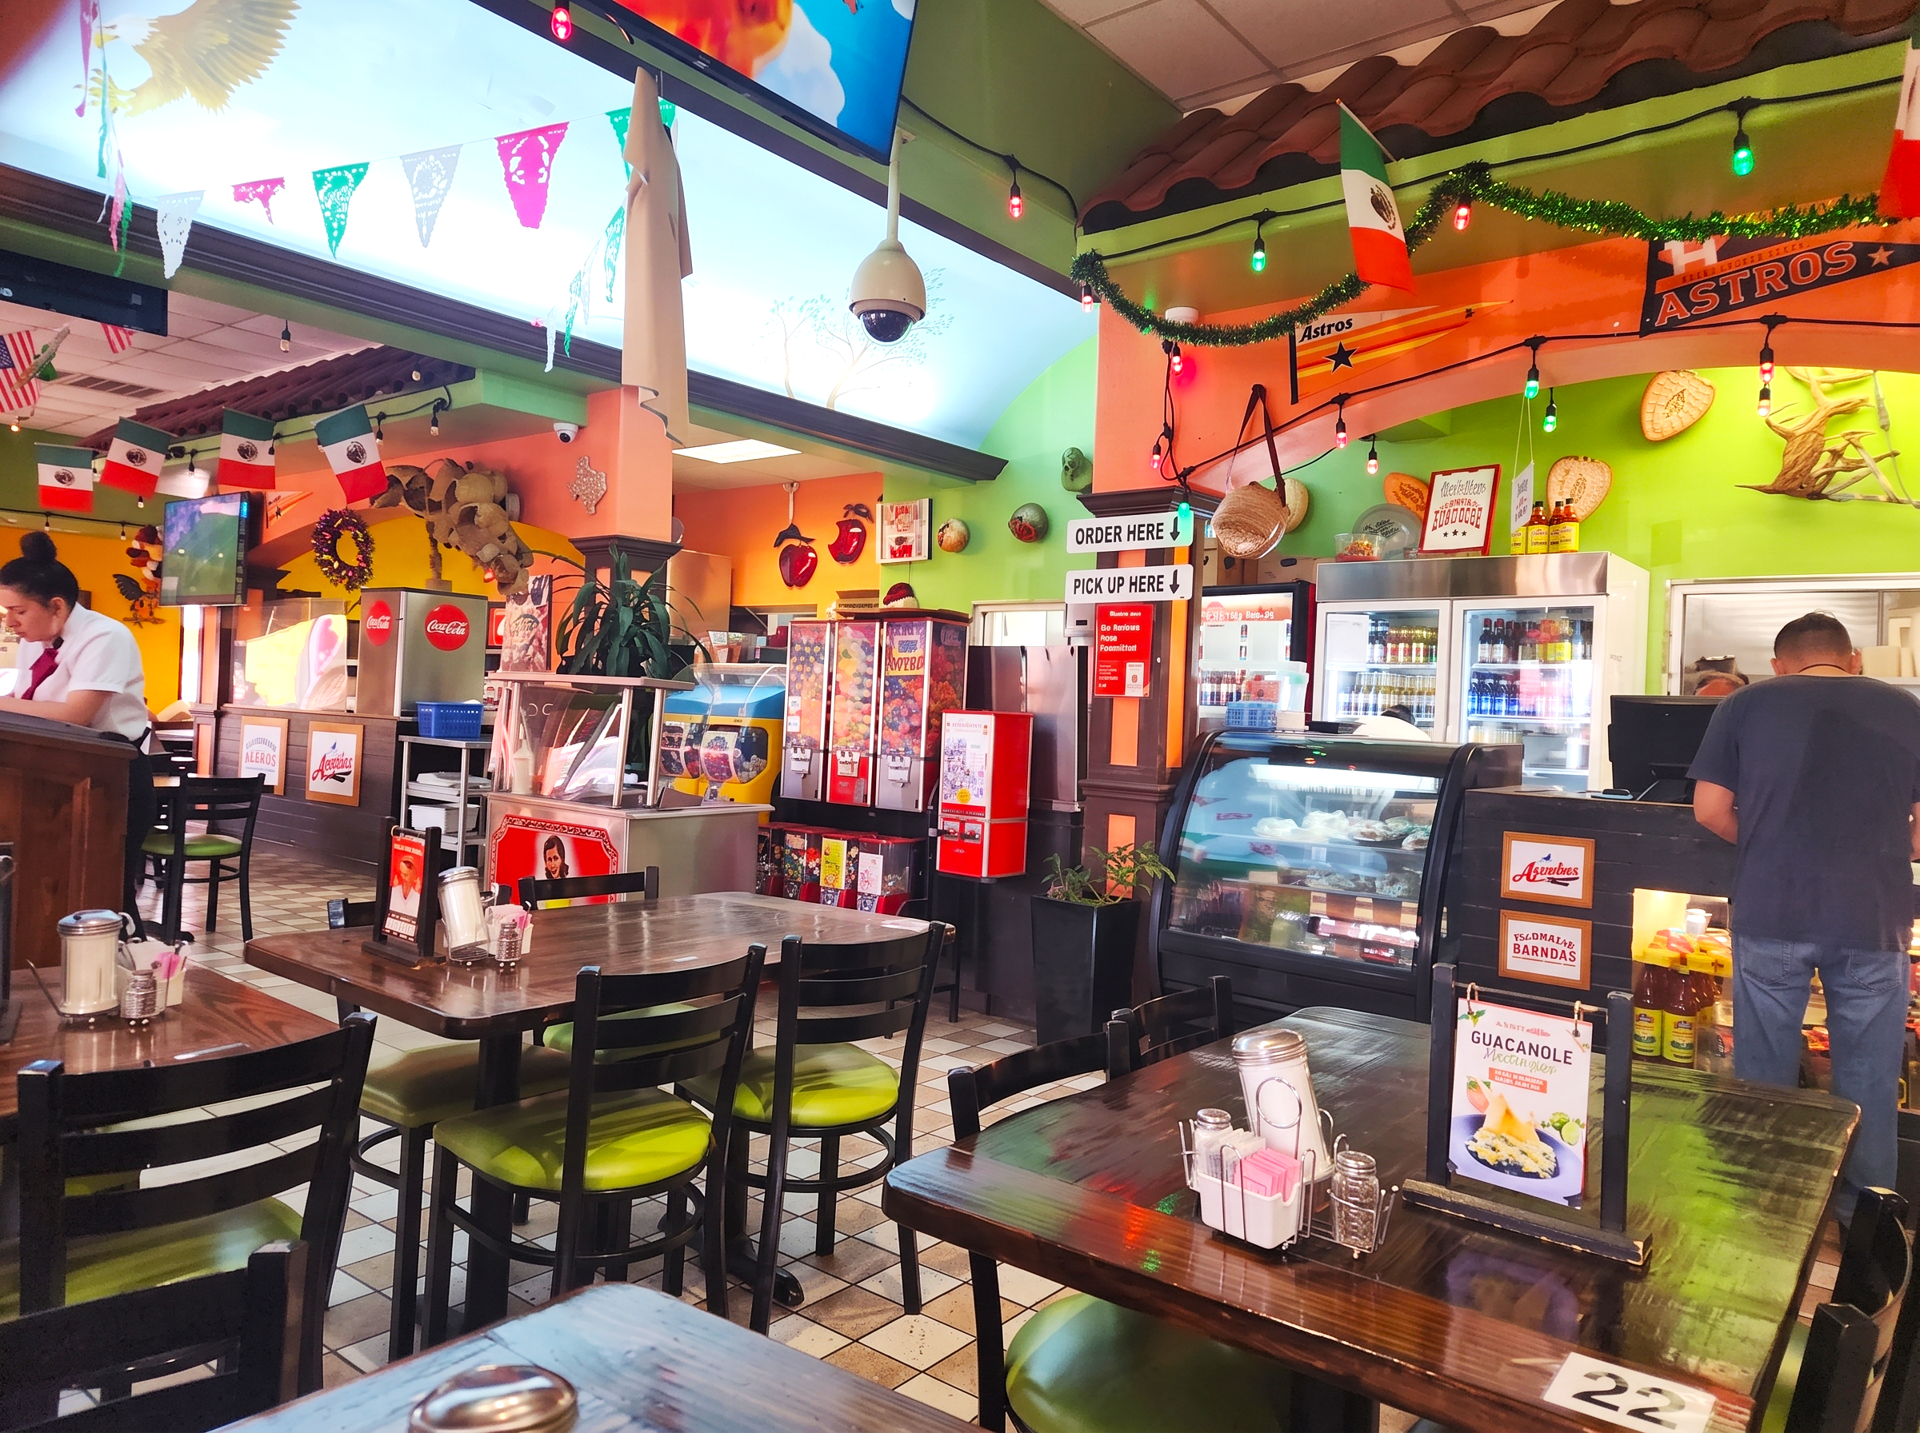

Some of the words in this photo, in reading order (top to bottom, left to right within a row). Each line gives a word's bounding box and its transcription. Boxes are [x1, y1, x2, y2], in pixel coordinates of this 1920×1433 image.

[1655, 241, 1857, 327] ASTROS
[1298, 318, 1353, 343] Astros
[1075, 525, 1122, 545] ORDER
[1127, 522, 1164, 541] HERE
[1073, 577, 1103, 595] PICK
[1107, 576, 1125, 594] UP
[1129, 574, 1164, 593] HERE
[1513, 943, 1577, 962] BARNDAS
[1471, 1030, 1573, 1065] GUACANOLE
[1571, 1371, 1686, 1430] 22
